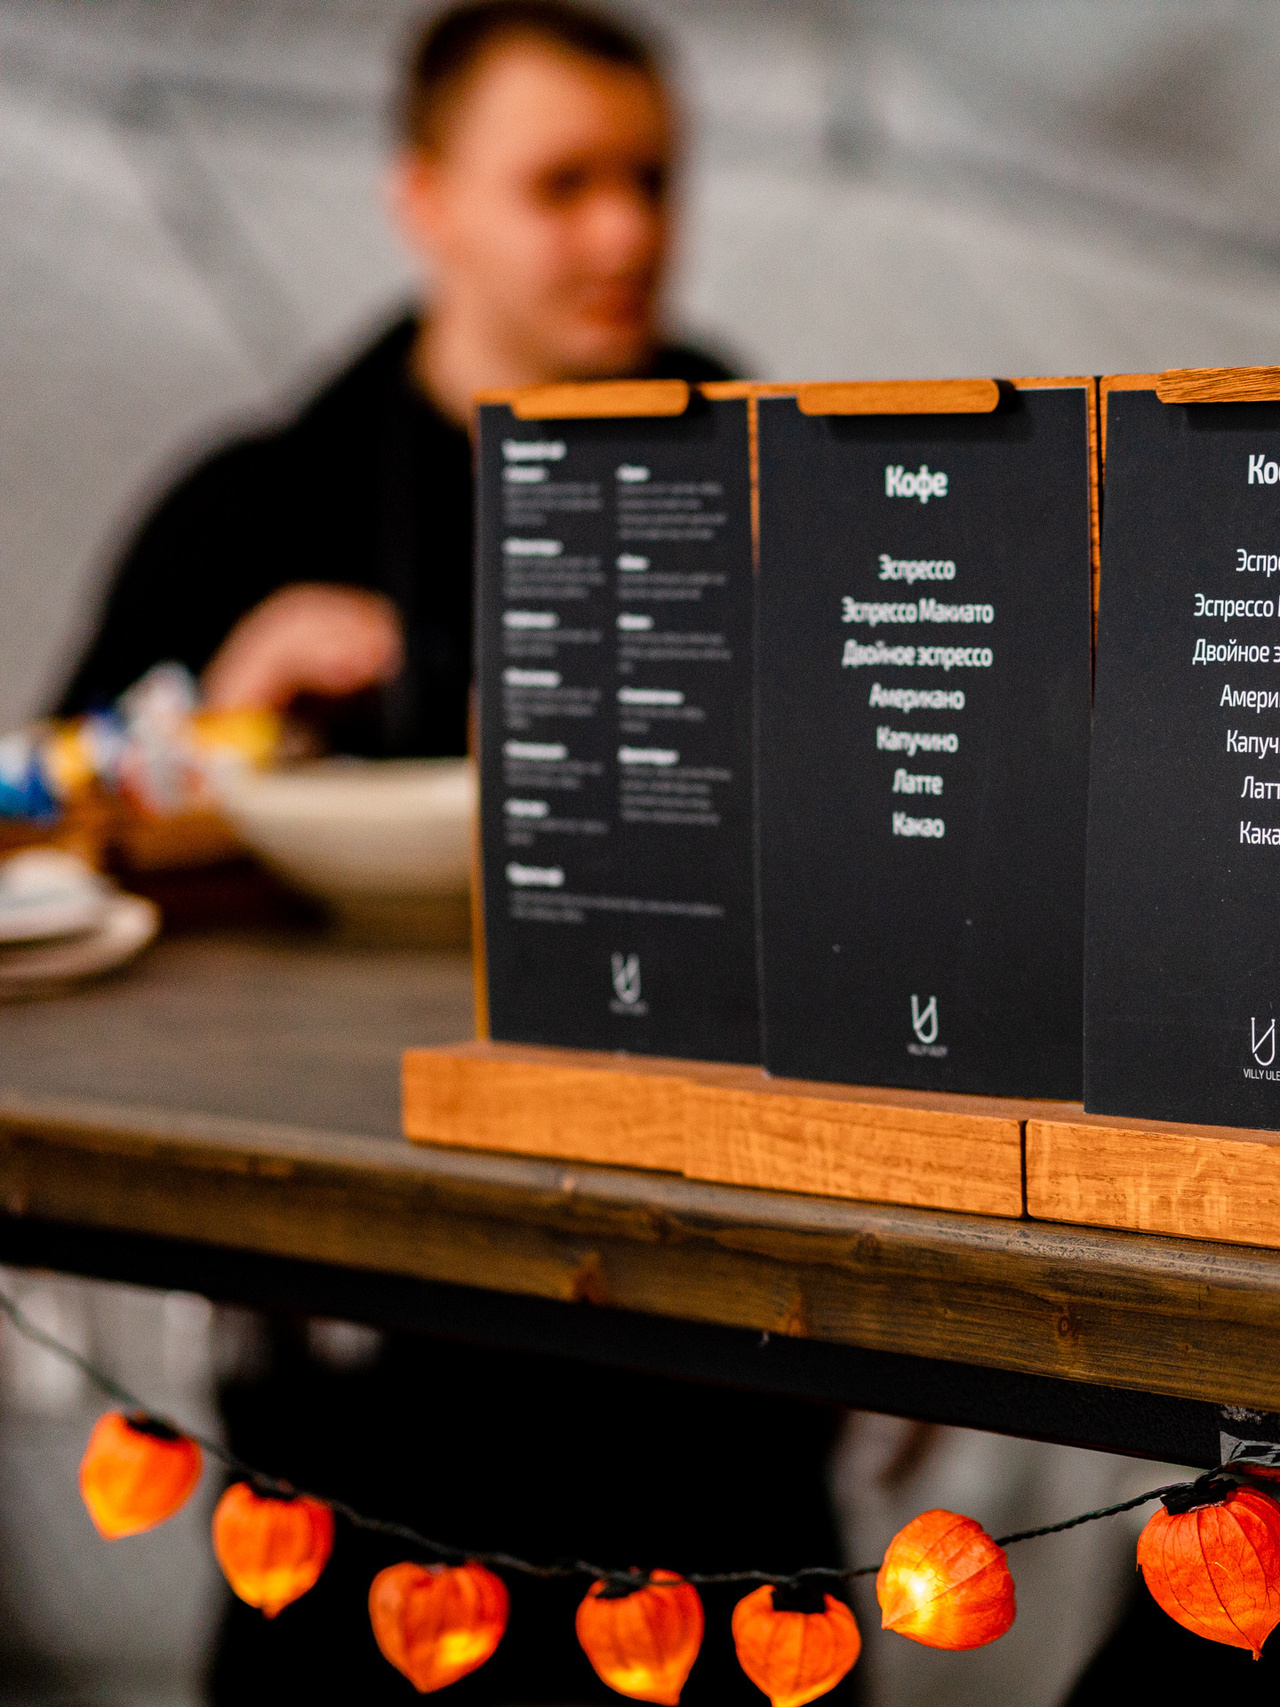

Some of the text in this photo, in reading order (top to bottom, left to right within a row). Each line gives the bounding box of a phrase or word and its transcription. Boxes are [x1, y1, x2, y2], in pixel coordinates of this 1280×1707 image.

[885, 465, 948, 504] Кофе
[879, 554, 956, 584] Эспрессо
[842, 596, 994, 627] Эспрессо Макиато
[1194, 593, 1274, 622] Эспрессо
[842, 639, 993, 671] Двойное эспрессо
[1192, 639, 1269, 666] Двойное
[869, 683, 965, 713] Американо
[877, 726, 958, 756] Капучино
[892, 769, 943, 795] Латте
[893, 812, 945, 838] Какао
[1243, 1068, 1264, 1080] VILLY
